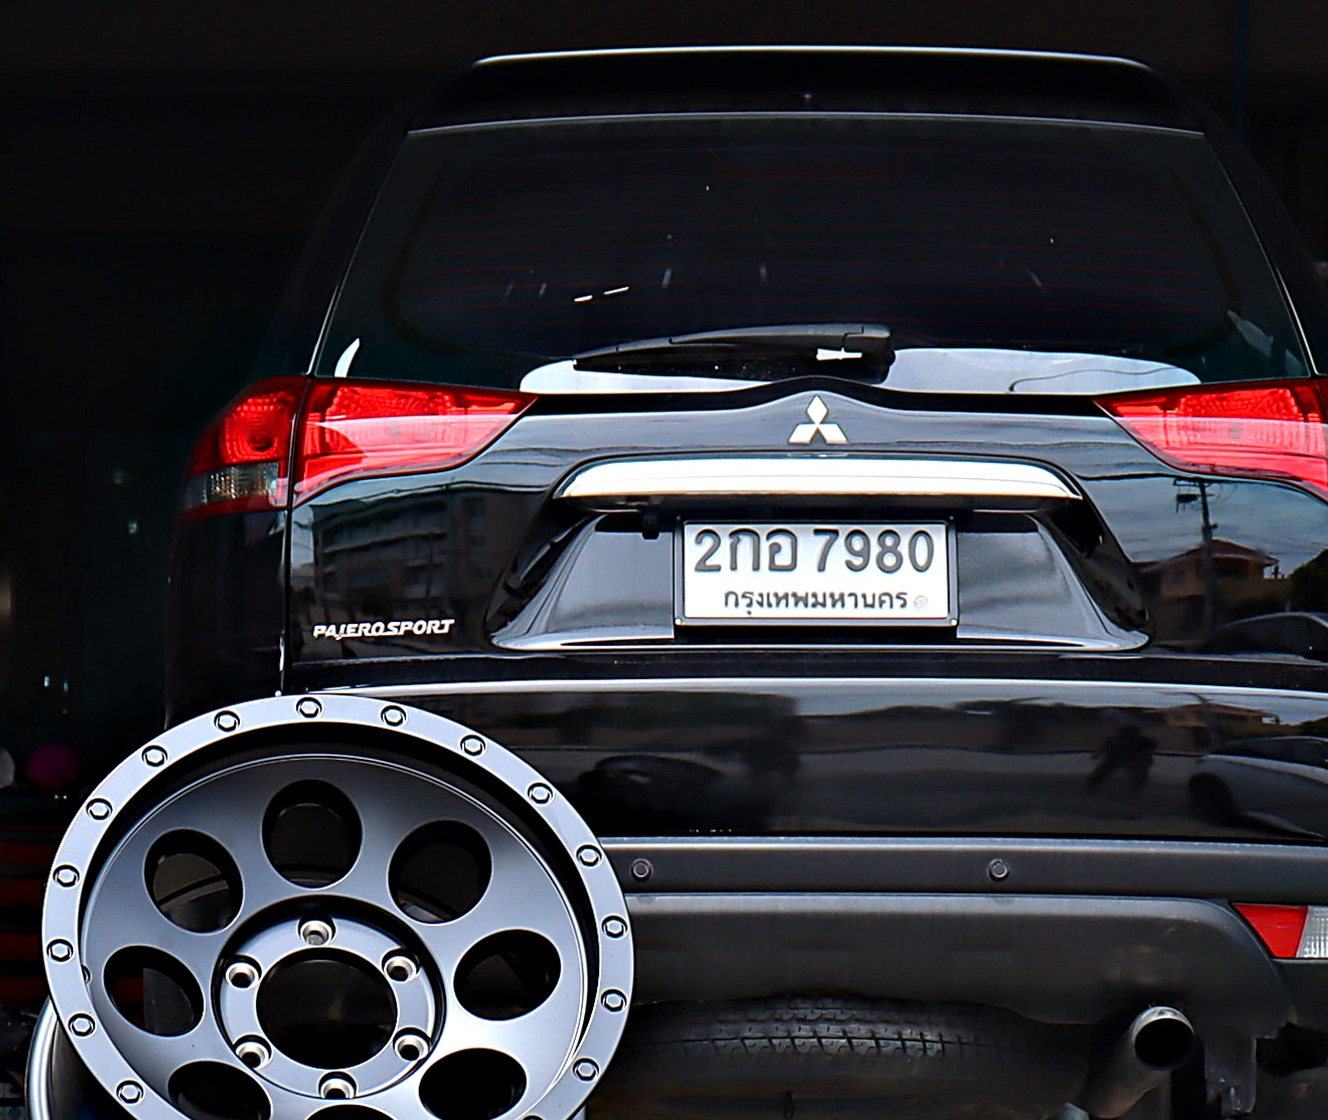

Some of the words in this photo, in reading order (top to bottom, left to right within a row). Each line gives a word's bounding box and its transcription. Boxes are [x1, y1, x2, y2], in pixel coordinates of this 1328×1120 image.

[693, 527, 798, 573] 2กอ
[812, 528, 935, 574] 7980
[723, 590, 908, 616] กรุงเทพมหานคร
